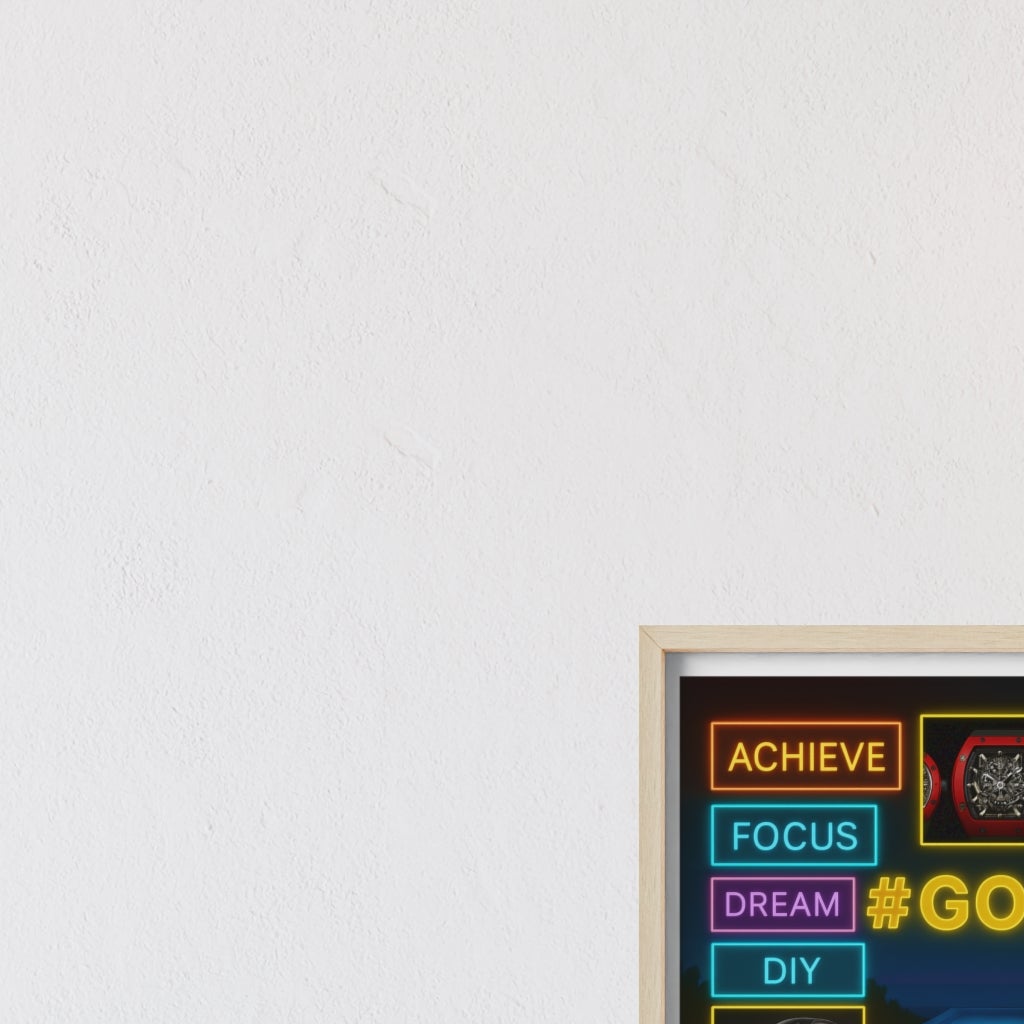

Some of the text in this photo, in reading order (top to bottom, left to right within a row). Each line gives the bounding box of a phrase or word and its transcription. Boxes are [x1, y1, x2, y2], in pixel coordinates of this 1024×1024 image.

[728, 741, 886, 773] ACHIEVE
[732, 821, 859, 852] FOCUS
[725, 891, 840, 918] DREAM
[763, 957, 821, 985] DIY
